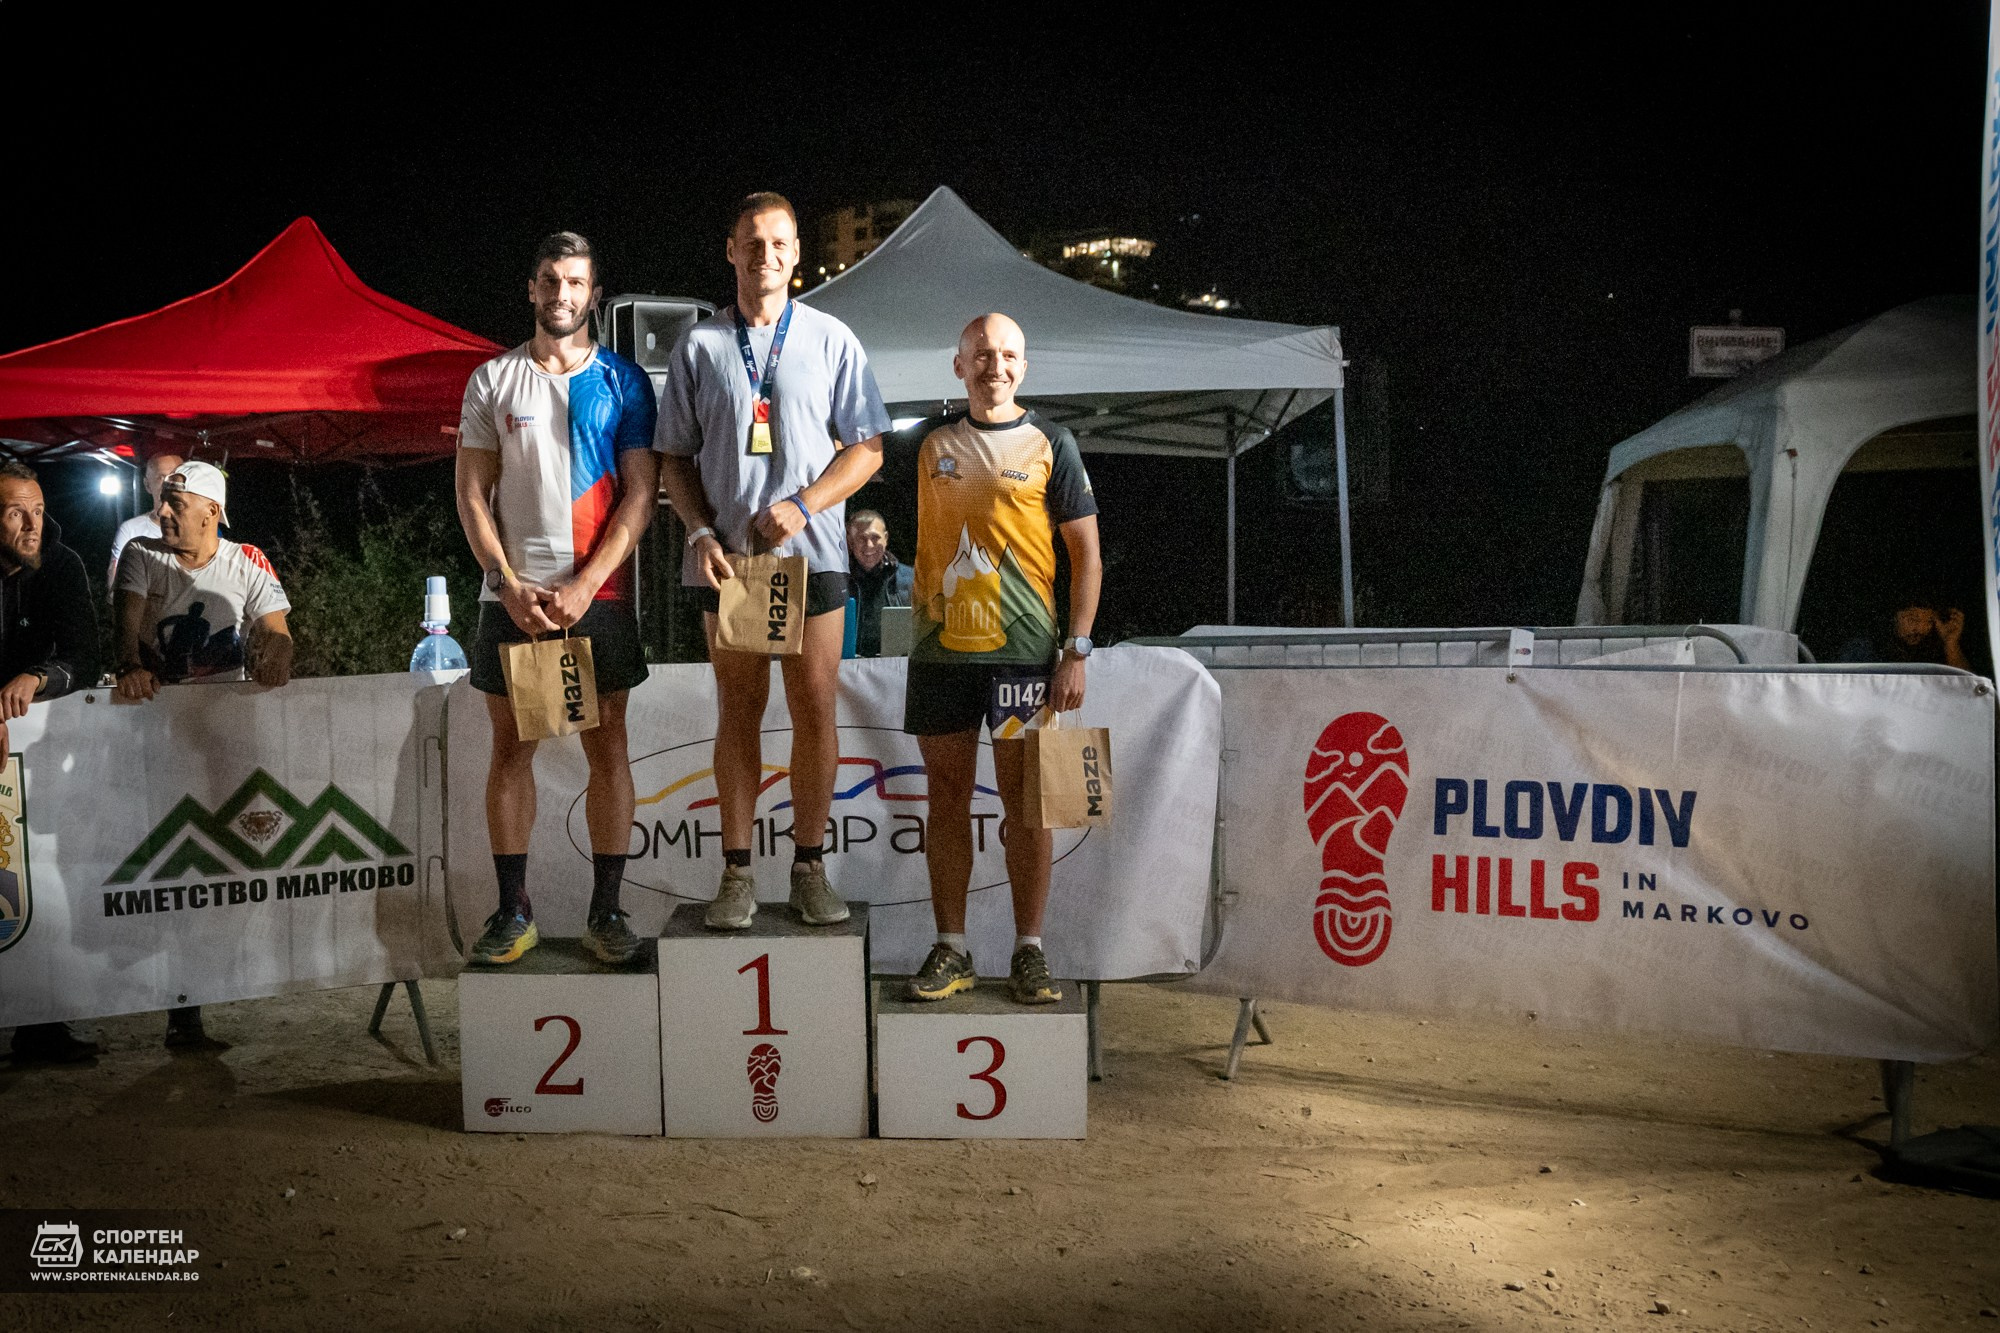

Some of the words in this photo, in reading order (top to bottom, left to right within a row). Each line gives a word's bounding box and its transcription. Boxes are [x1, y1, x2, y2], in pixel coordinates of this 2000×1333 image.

[998, 682, 1046, 707] 0142
[1434, 778, 1697, 848] PLOVDIV
[104, 877, 268, 917] КМЕТСТВО
[276, 862, 414, 900] МАРКОВО
[1431, 854, 1600, 922] HILLS
[1623, 872, 1656, 891] IN
[1623, 901, 1809, 931] MARKOVO
[736, 953, 789, 1036] 1
[533, 1015, 584, 1095] 2
[956, 1035, 1008, 1121] 3
